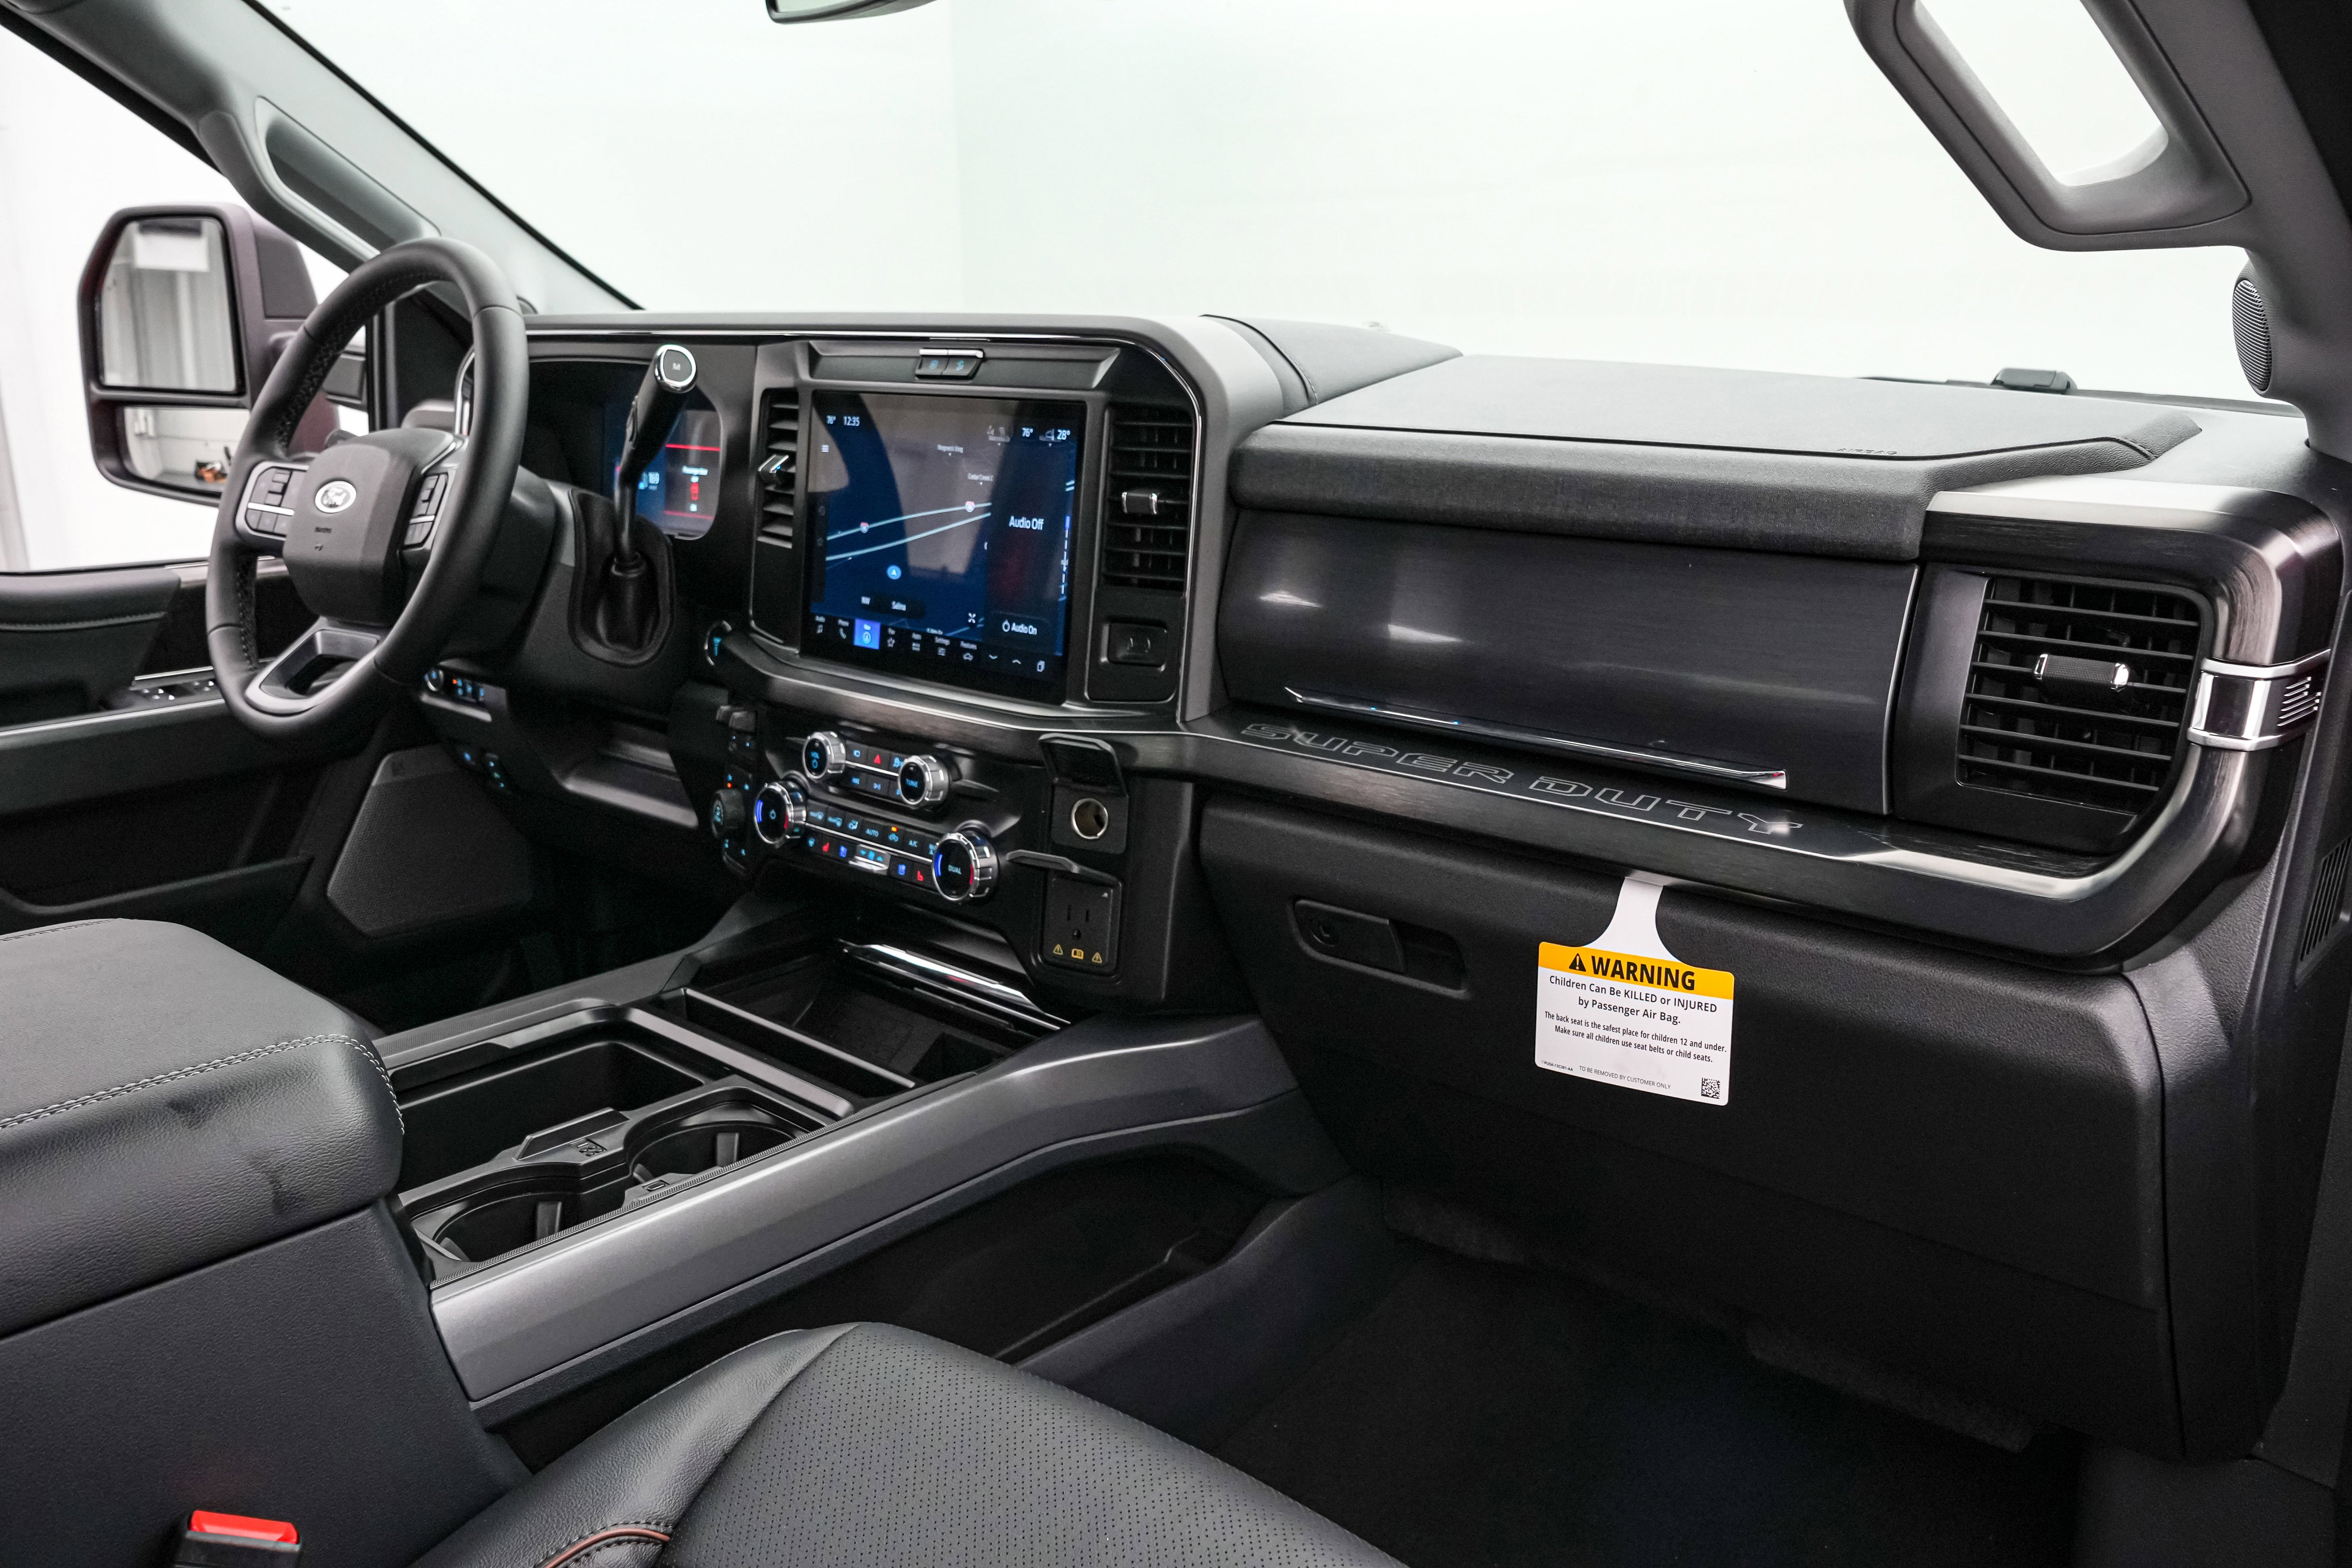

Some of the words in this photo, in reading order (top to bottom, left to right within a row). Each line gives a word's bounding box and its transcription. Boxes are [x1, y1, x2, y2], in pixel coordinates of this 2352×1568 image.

[1009, 515, 1031, 529] Audio
[1031, 518, 1044, 530] Off
[1011, 622, 1028, 633] Audio
[1028, 625, 1037, 635] On
[1241, 723, 1515, 784] SUPER
[1528, 776, 1803, 835] DUTY
[866, 828, 879, 837] AUTO
[948, 864, 962, 875] DUAL
[1591, 955, 1695, 991] WARNING
[1550, 975, 1586, 990] Children
[1589, 983, 1606, 994] Can
[1609, 987, 1621, 997] Be
[1624, 989, 1657, 1003] KILLED
[1674, 998, 1717, 1012] INJURED
[1578, 996, 1589, 1009] by
[1592, 999, 1640, 1017] Passenger
[1642, 1009, 1657, 1019] Air
[1660, 1011, 1681, 1025] Bag.
[1545, 1011, 1555, 1020] The
[1556, 1013, 1569, 1023] back
[1570, 1018, 1583, 1026] seat
[1591, 1021, 1601, 1029] the
[1602, 1024, 1621, 1033] safest
[1622, 1027, 1638, 1037] place
[1640, 1030, 1650, 1039] for
[1651, 1033, 1677, 1044] children
[1680, 1038, 1688, 1046] 12
[1704, 1043, 1727, 1052] under.
[1555, 1025, 1570, 1035] Make
[1572, 1030, 1584, 1038] sure
[1595, 1034, 1619, 1045] children
[1634, 1042, 1647, 1051] seat
[1649, 1044, 1664, 1054] belts
[1675, 1049, 1691, 1059] child
[1693, 1054, 1713, 1062] seats.
[1594, 1069, 1618, 1078] REMOVED
[1627, 1076, 1655, 1087] CUSTOMER
